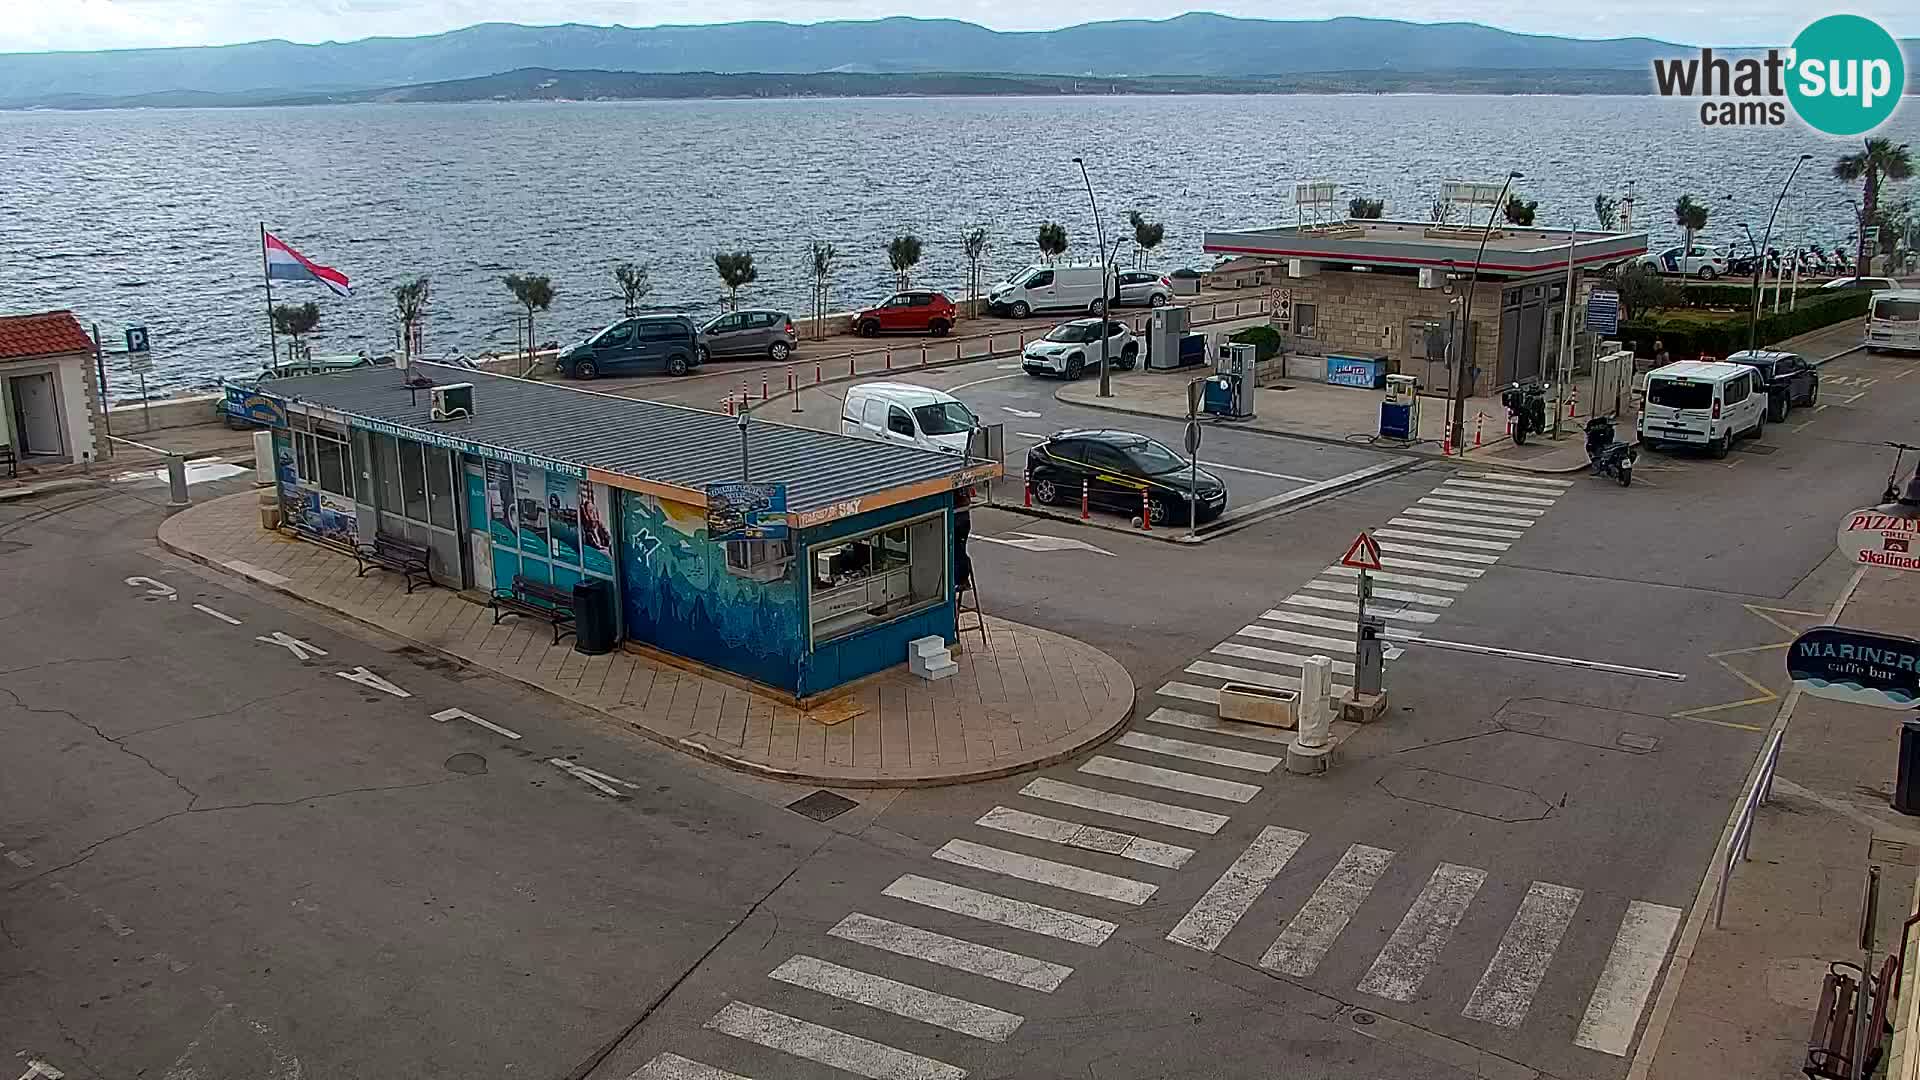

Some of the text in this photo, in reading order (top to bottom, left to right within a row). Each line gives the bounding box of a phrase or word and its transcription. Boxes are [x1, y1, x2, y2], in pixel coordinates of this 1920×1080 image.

[131, 331, 144, 350] P
[479, 446, 494, 457] BUS
[494, 449, 526, 465] STATION
[529, 457, 555, 472] TICKET
[555, 464, 583, 477] OFFICE
[1848, 516, 1920, 534] PIZZE
[1828, 663, 1896, 680] caffe bar
